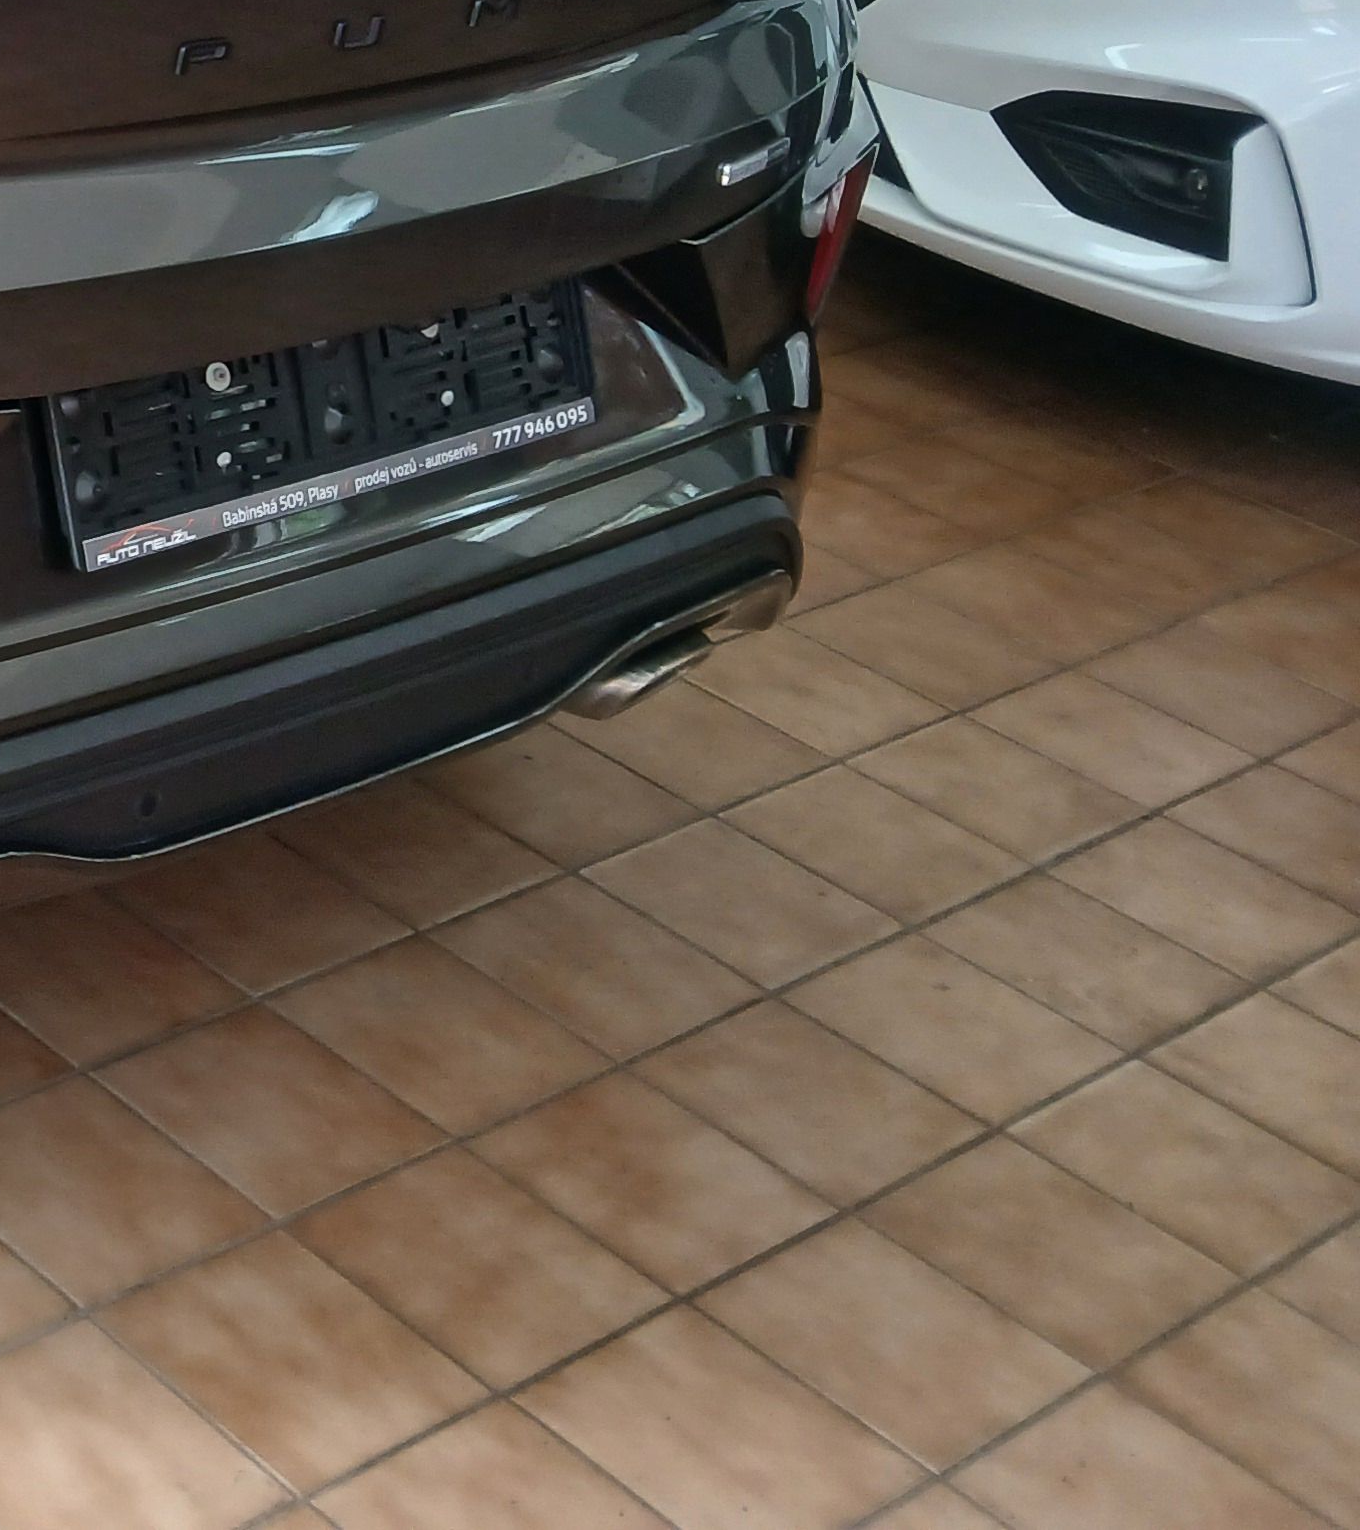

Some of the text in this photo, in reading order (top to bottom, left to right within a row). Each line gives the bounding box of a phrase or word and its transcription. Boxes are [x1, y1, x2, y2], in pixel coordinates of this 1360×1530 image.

[222, 498, 278, 528] Babinská
[279, 492, 308, 512] 509,
[308, 484, 339, 506] Plasy
[354, 464, 390, 495] prodej
[390, 457, 417, 479] vozů
[424, 441, 478, 470] autoservis
[492, 425, 521, 449] 777
[524, 418, 555, 439] 946
[555, 404, 587, 430] 095
[95, 544, 140, 567] AUTO
